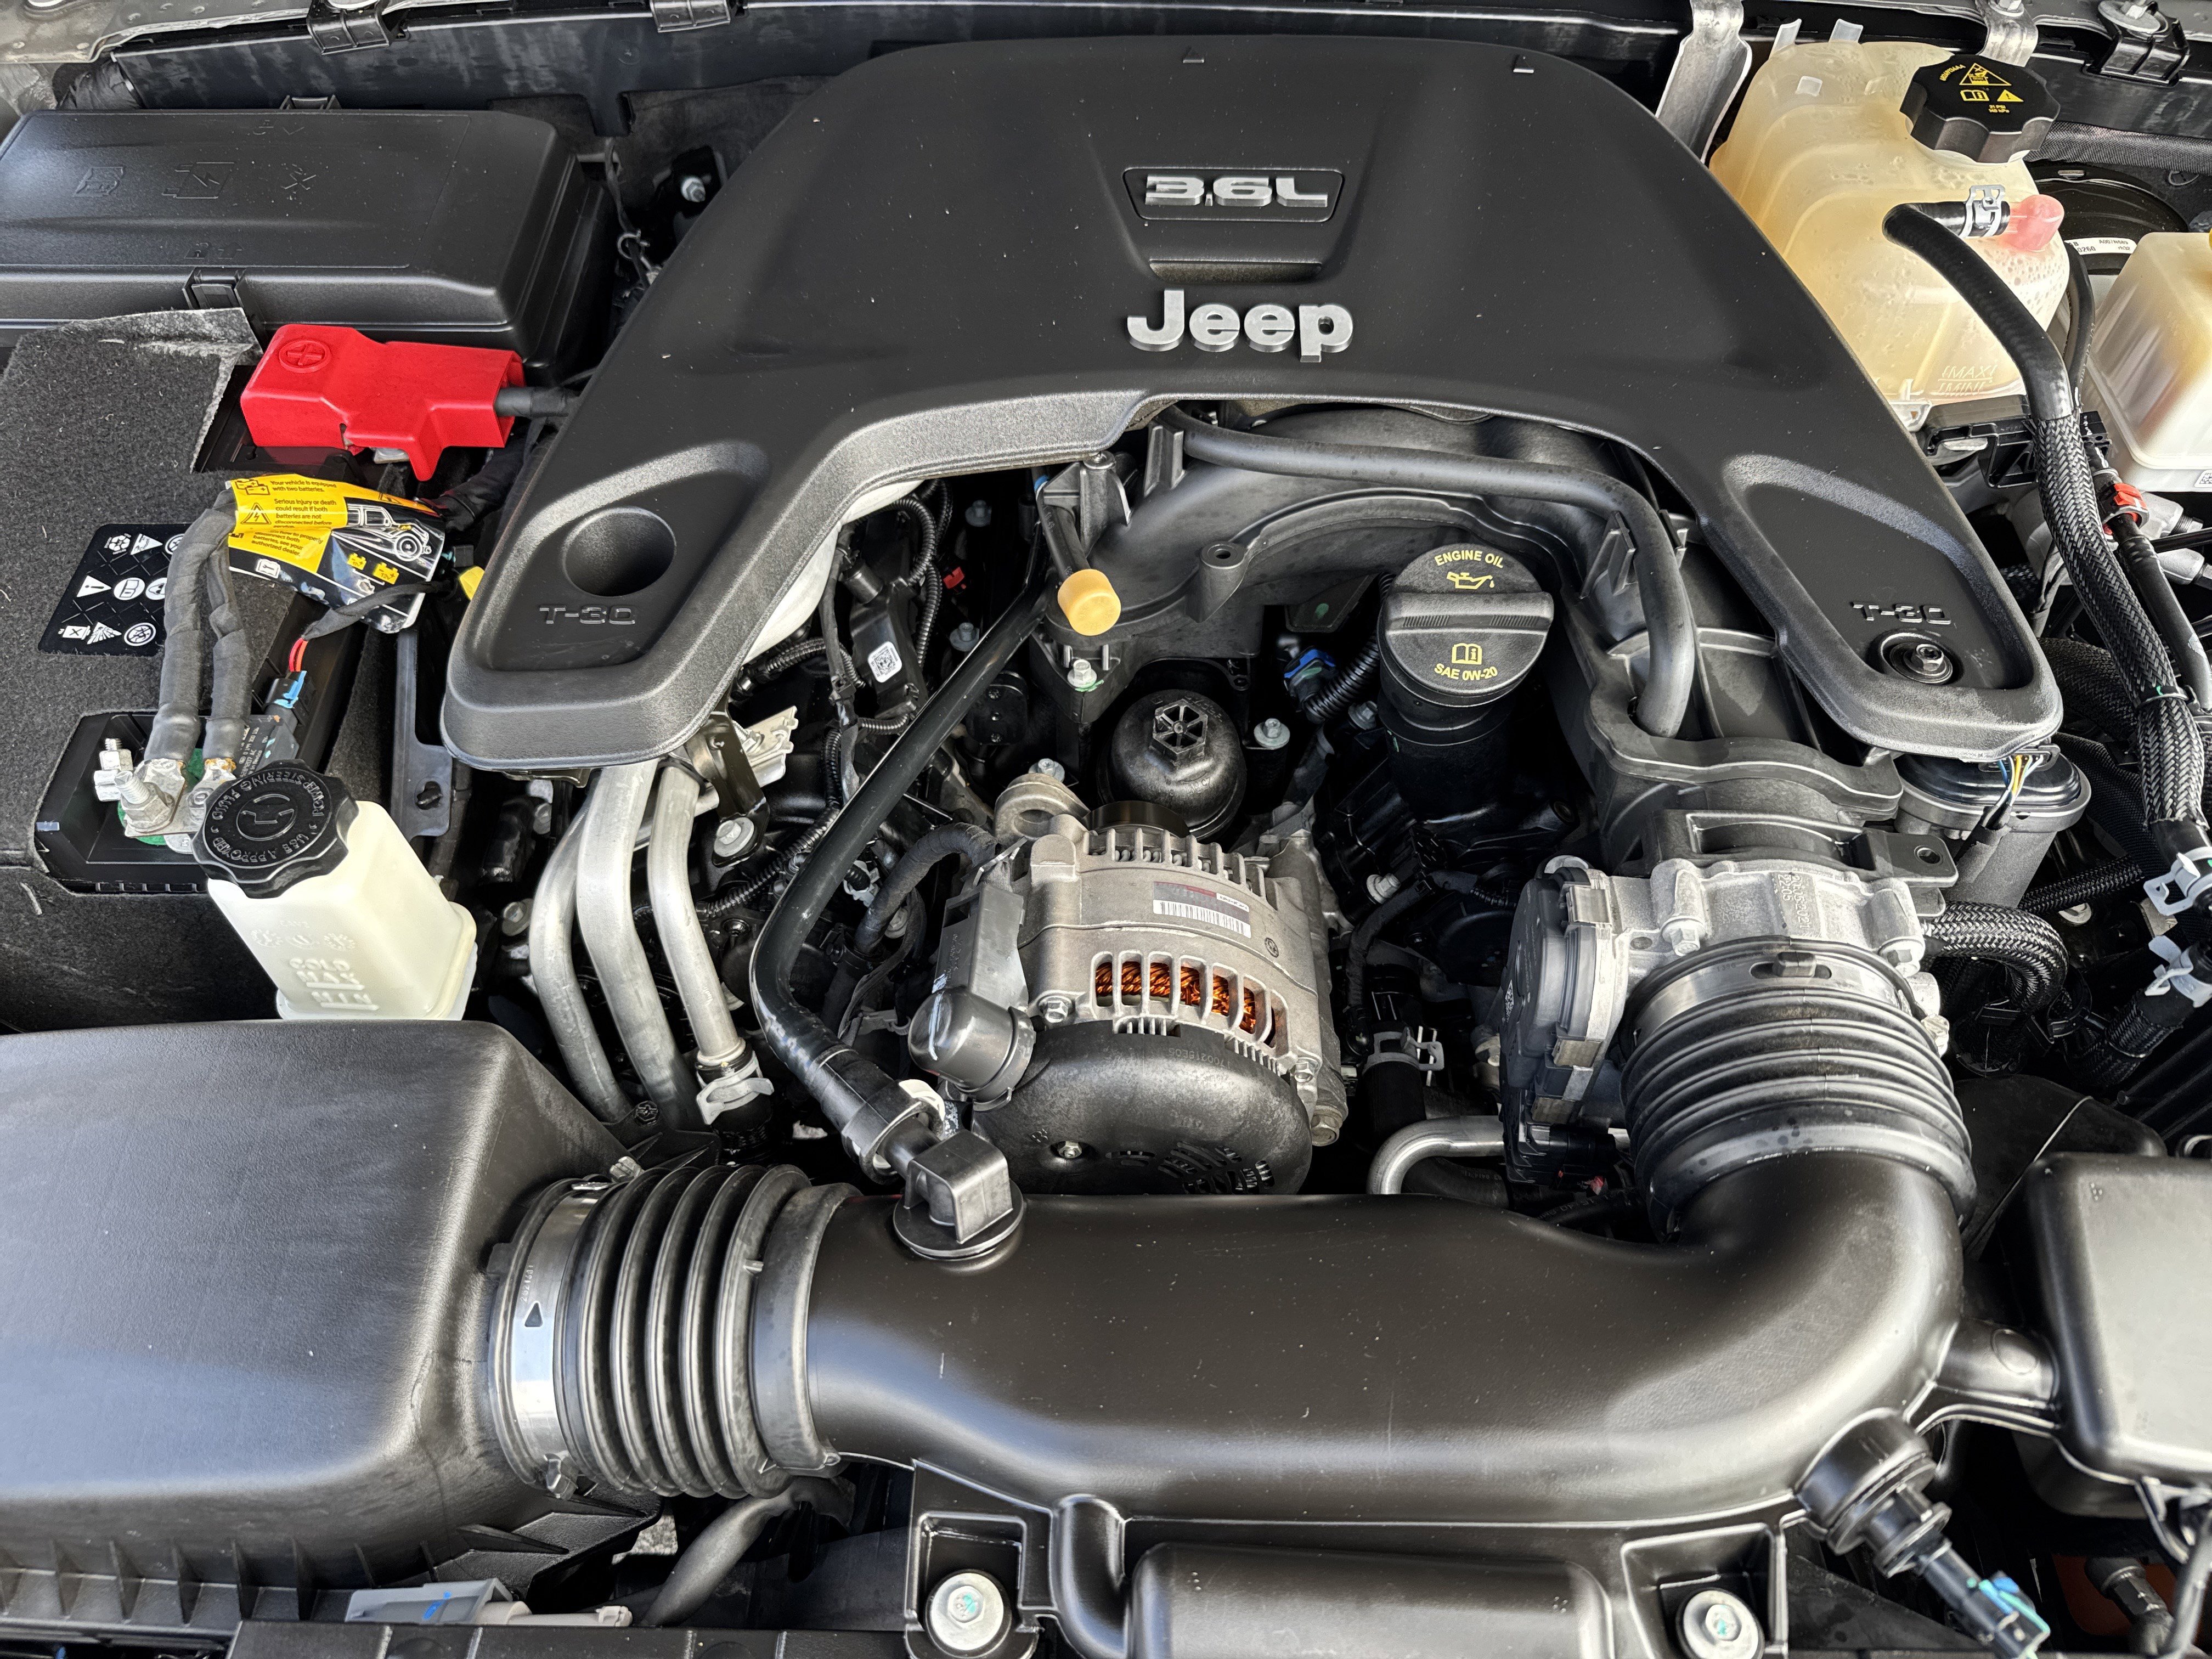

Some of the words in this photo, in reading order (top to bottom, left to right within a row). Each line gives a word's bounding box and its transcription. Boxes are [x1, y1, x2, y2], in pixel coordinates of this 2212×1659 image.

[1145, 175, 1328, 207] 3.6L
[1127, 289, 1353, 363] Jeep
[251, 540, 282, 550] authorized
[253, 535, 279, 544] batteries,
[290, 542, 303, 550] your
[300, 534, 324, 544] properly
[1434, 550, 1483, 566] ENGINE
[1485, 552, 1504, 568] OIL
[539, 604, 636, 625] T-30
[1852, 602, 1952, 625] T-30
[1434, 663, 1459, 680] SAE
[1462, 665, 1498, 681] 0W-20
[240, 770, 306, 791] STEERING
[212, 789, 241, 820] FLUID
[289, 957, 350, 972] COLD
